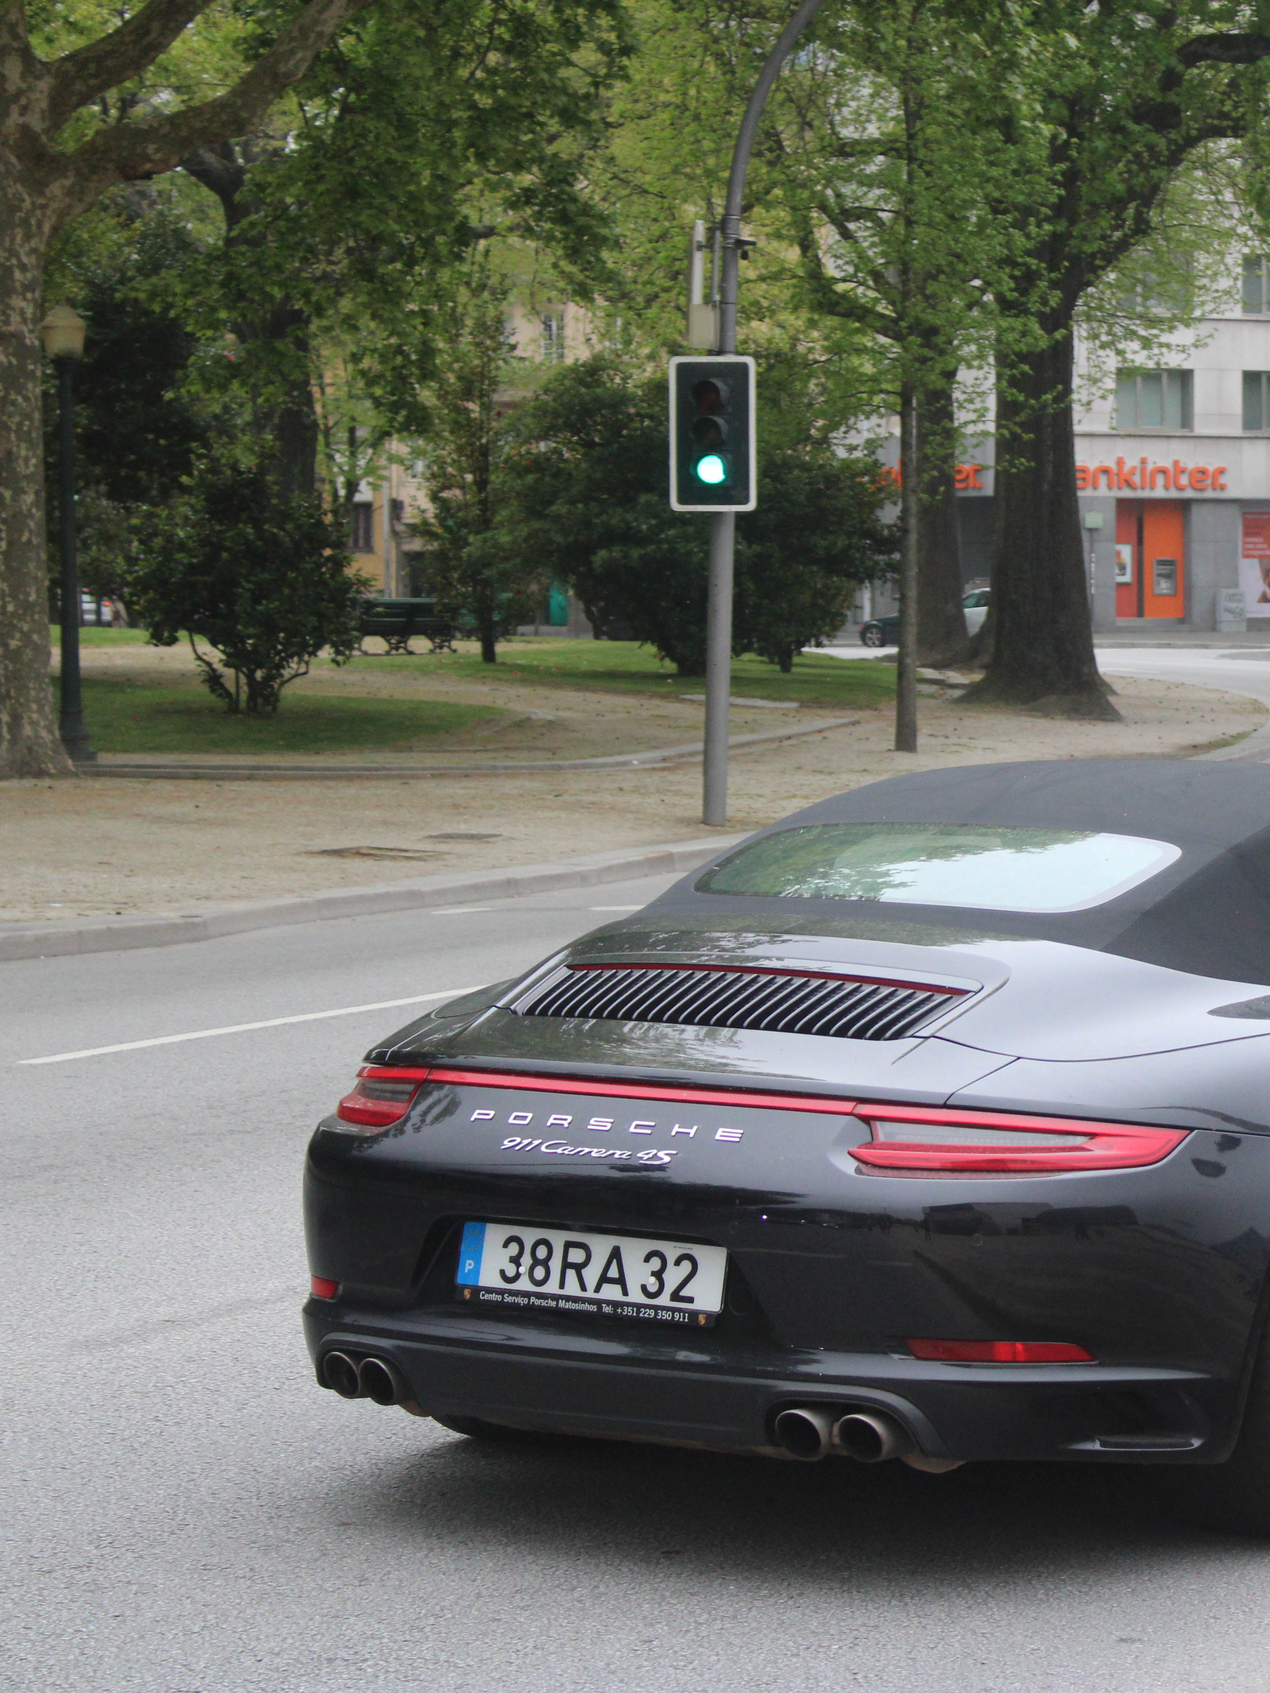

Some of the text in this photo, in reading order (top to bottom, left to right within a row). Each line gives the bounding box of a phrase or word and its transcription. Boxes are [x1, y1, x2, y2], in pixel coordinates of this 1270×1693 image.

[470, 1109, 744, 1143] PORSCHE
[500, 1136, 678, 1165] 911 Carrera 4S
[464, 1260, 475, 1274] P
[480, 1291, 689, 1322] Centro Serviço Porsche Matosinhos Tel: +351 229 350 911
